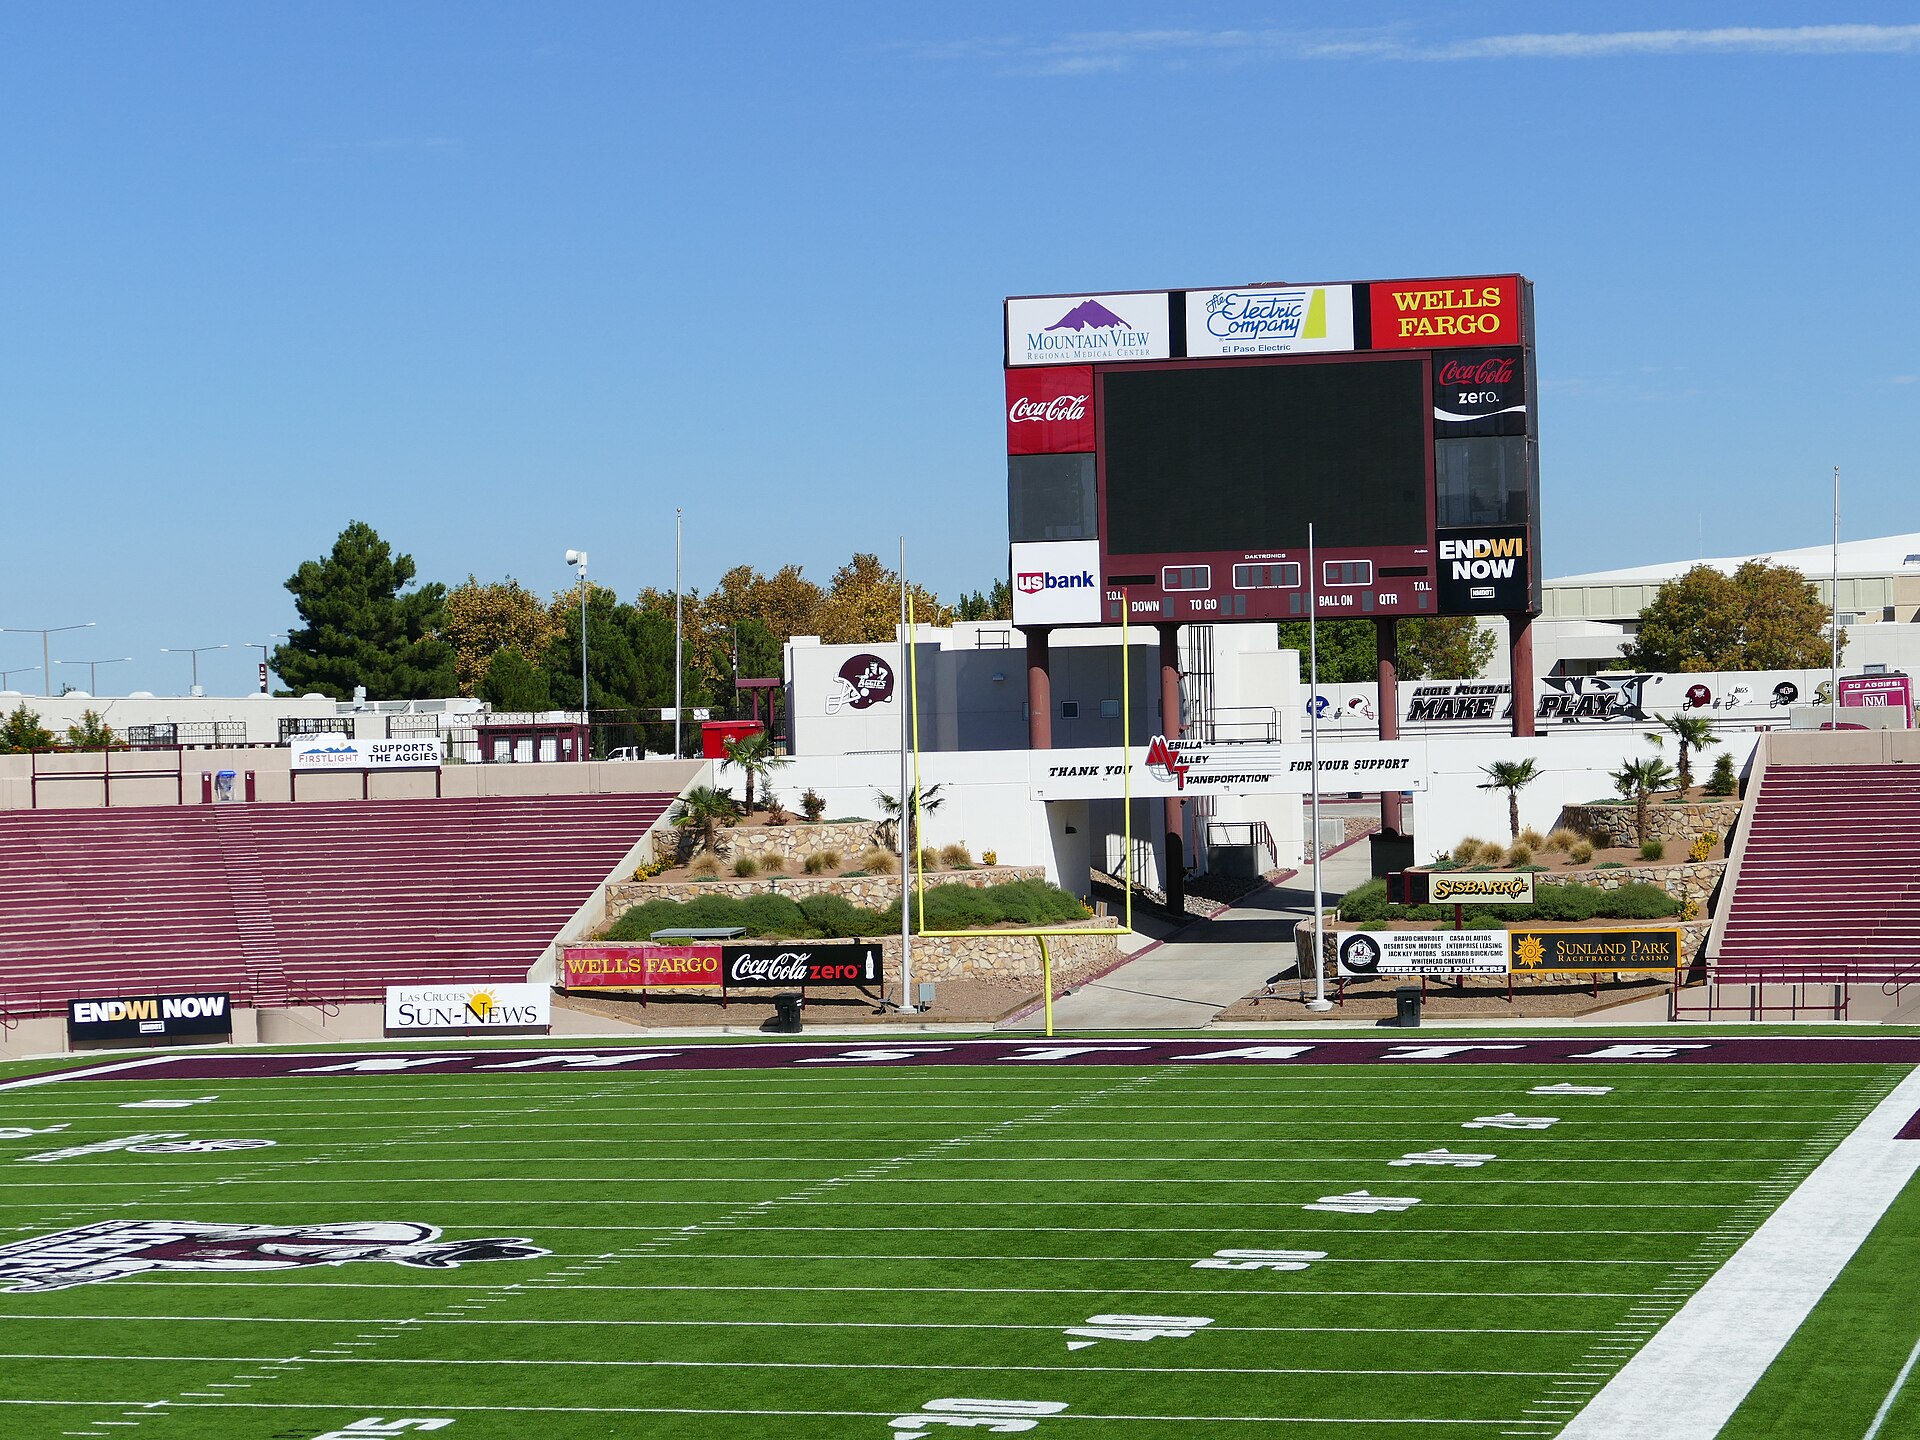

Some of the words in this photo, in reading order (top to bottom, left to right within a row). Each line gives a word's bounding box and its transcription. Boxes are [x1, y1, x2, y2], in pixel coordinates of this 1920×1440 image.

[1222, 292, 1305, 320] Electric
[1392, 287, 1501, 312] WELLS
[1207, 310, 1300, 339] Company
[1398, 313, 1500, 337] FARGO
[1027, 351, 1070, 360] REGIONAL
[1074, 350, 1112, 359] MEDICAL
[1117, 348, 1150, 357] CENTER
[1222, 345, 1231, 353] El
[1234, 345, 1255, 353] Paso
[1258, 343, 1291, 352] Electric
[1439, 357, 1517, 386] Coca-Cola
[1009, 395, 1090, 423] Coca-Cola
[1439, 538, 1523, 560] ENDWI
[1452, 559, 1515, 580] NOW
[1413, 581, 1432, 591] T.O.L.
[1131, 600, 1160, 612] DOWN
[1190, 599, 1202, 611] TO
[1203, 598, 1217, 610] GO
[1319, 595, 1340, 607] BALL
[1341, 595, 1353, 606] ON
[1379, 593, 1398, 605] QTR
[1413, 686, 1452, 696] AGGIE
[1454, 684, 1512, 695] FOOTBAL
[1406, 695, 1498, 721] MAKE
[1536, 693, 1618, 717] PLAY
[1864, 695, 1885, 706] NM
[368, 754, 391, 763] THE
[394, 752, 438, 762] AGGIES
[372, 743, 434, 753] SUPPORTS
[1049, 765, 1100, 777] THANK
[1289, 760, 1313, 772] FOR
[1317, 759, 1349, 771] YOUR
[1353, 758, 1410, 770] SUPPORT
[1433, 877, 1526, 900] SISBARRO
[1556, 940, 1626, 955] SUNLAND
[1631, 940, 1669, 954] PARK
[566, 958, 641, 974] WELLS
[646, 957, 718, 973] FARGO
[731, 953, 811, 981] Coca-Cola
[400, 992, 420, 1002] LAS
[423, 991, 466, 1002] CRUCES
[73, 1000, 158, 1023] ENDWI
[162, 996, 225, 1019] NOW
[398, 1002, 537, 1026] SUN-NEWS
[1301, 1195, 1422, 1214] 40
[1190, 1249, 1329, 1270] 50
[1062, 1314, 1216, 1342] 40
[887, 1398, 1070, 1432] 30
